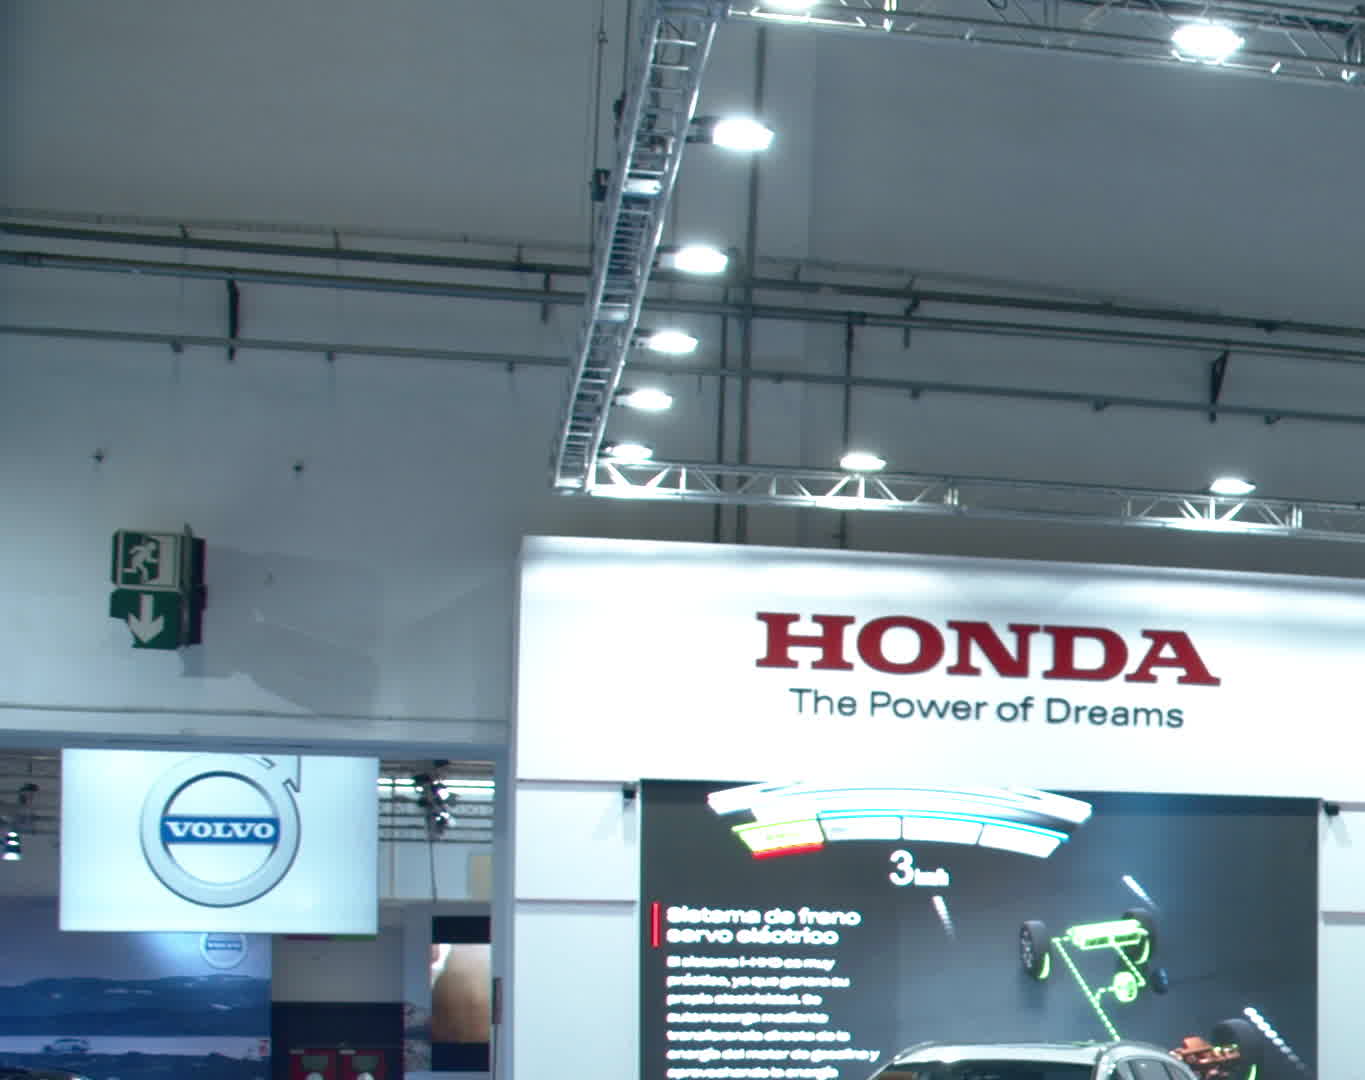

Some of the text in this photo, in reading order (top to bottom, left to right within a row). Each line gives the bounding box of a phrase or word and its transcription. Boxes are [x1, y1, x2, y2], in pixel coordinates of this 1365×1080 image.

[755, 611, 1221, 687] HONDA
[789, 687, 1184, 729] The Power of Dreams
[165, 821, 275, 838] VOLVO
[889, 849, 915, 886] 3
[667, 906, 861, 925] Sistema de freno
[667, 928, 734, 944] servo
